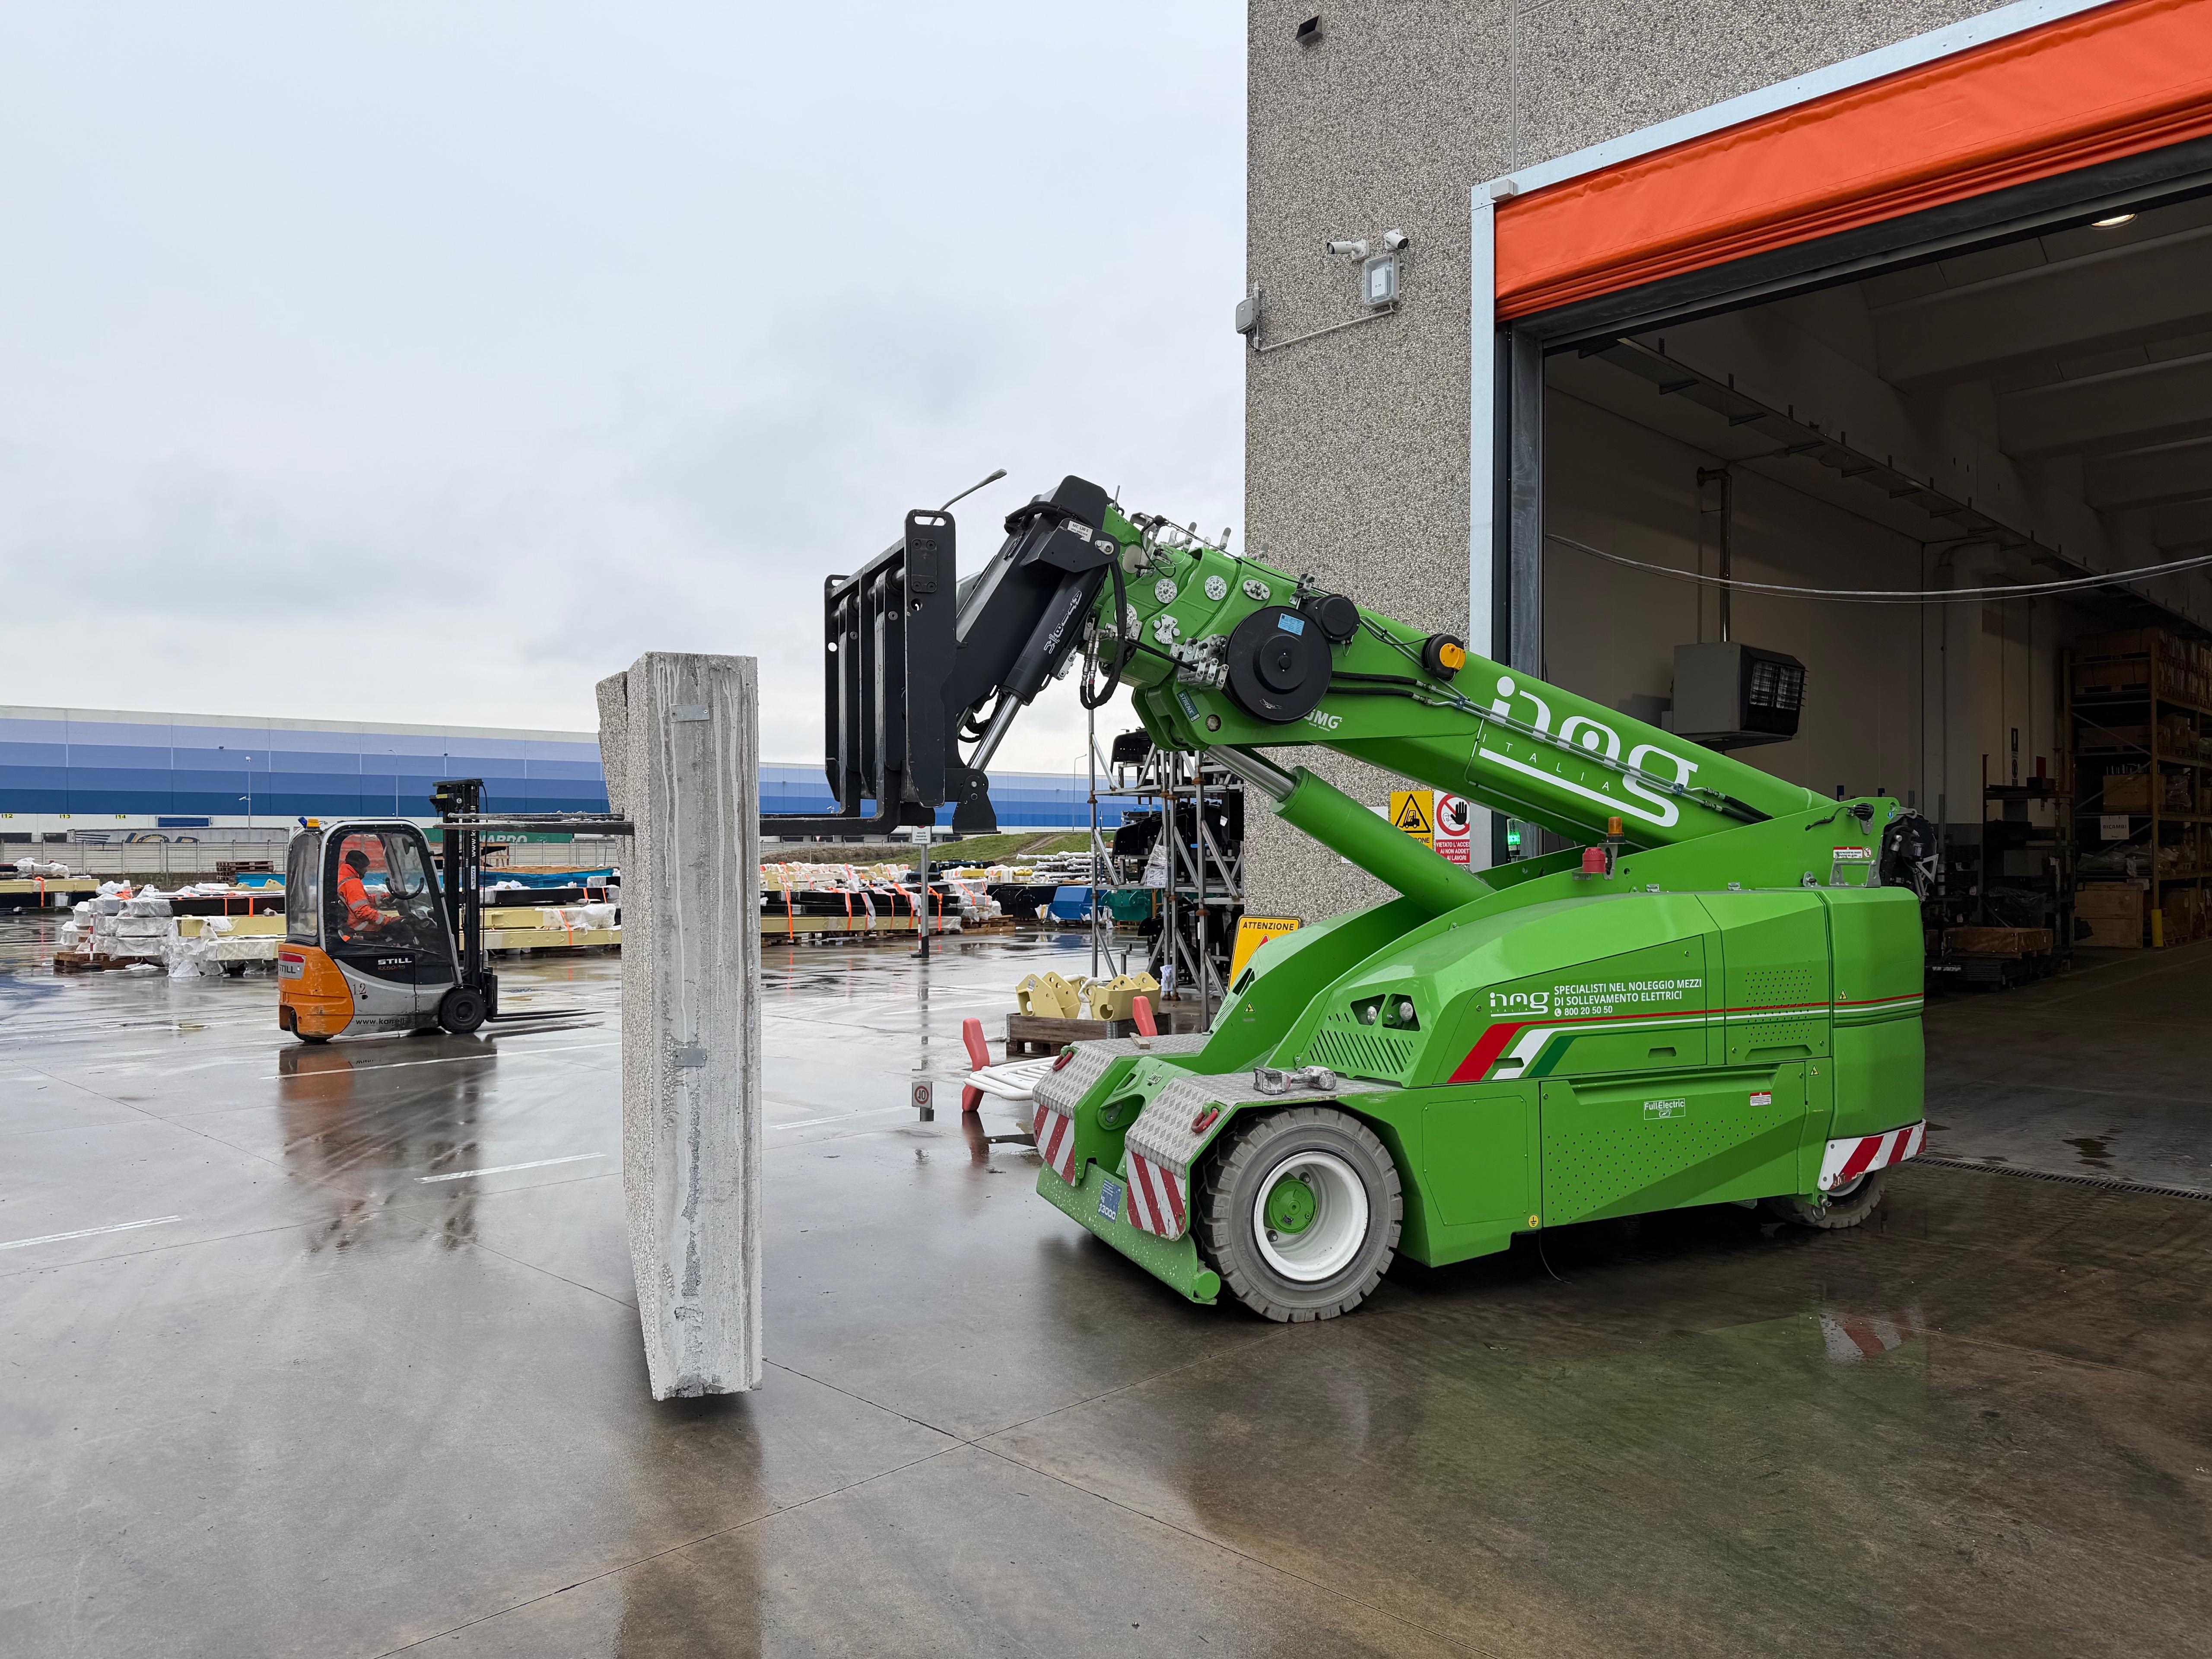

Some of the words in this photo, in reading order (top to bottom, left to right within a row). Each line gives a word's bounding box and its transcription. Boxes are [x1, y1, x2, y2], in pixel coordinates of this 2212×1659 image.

[1179, 693, 1194, 714] STRENX
[1483, 734, 1609, 791] ITALIA
[1243, 922, 1294, 931] ATTENZIONE
[1554, 983, 1606, 995] SPECIALISTI
[1609, 982, 1626, 992] NEL
[1629, 980, 1675, 991] NOLEGGIO
[1677, 979, 1701, 988] MEZZI
[1554, 997, 1564, 1006] DI
[1566, 992, 1639, 1006] SOLLEVAMENTO
[1641, 990, 1682, 1001] ELETTRICI
[1564, 1007, 1578, 1016] 800
[1580, 1007, 1590, 1015] 20
[1592, 1006, 1602, 1014] 50
[1603, 1005, 1613, 1014] 50
[1644, 1102, 1657, 1110] Full
[1658, 1100, 1684, 1109] Electric
